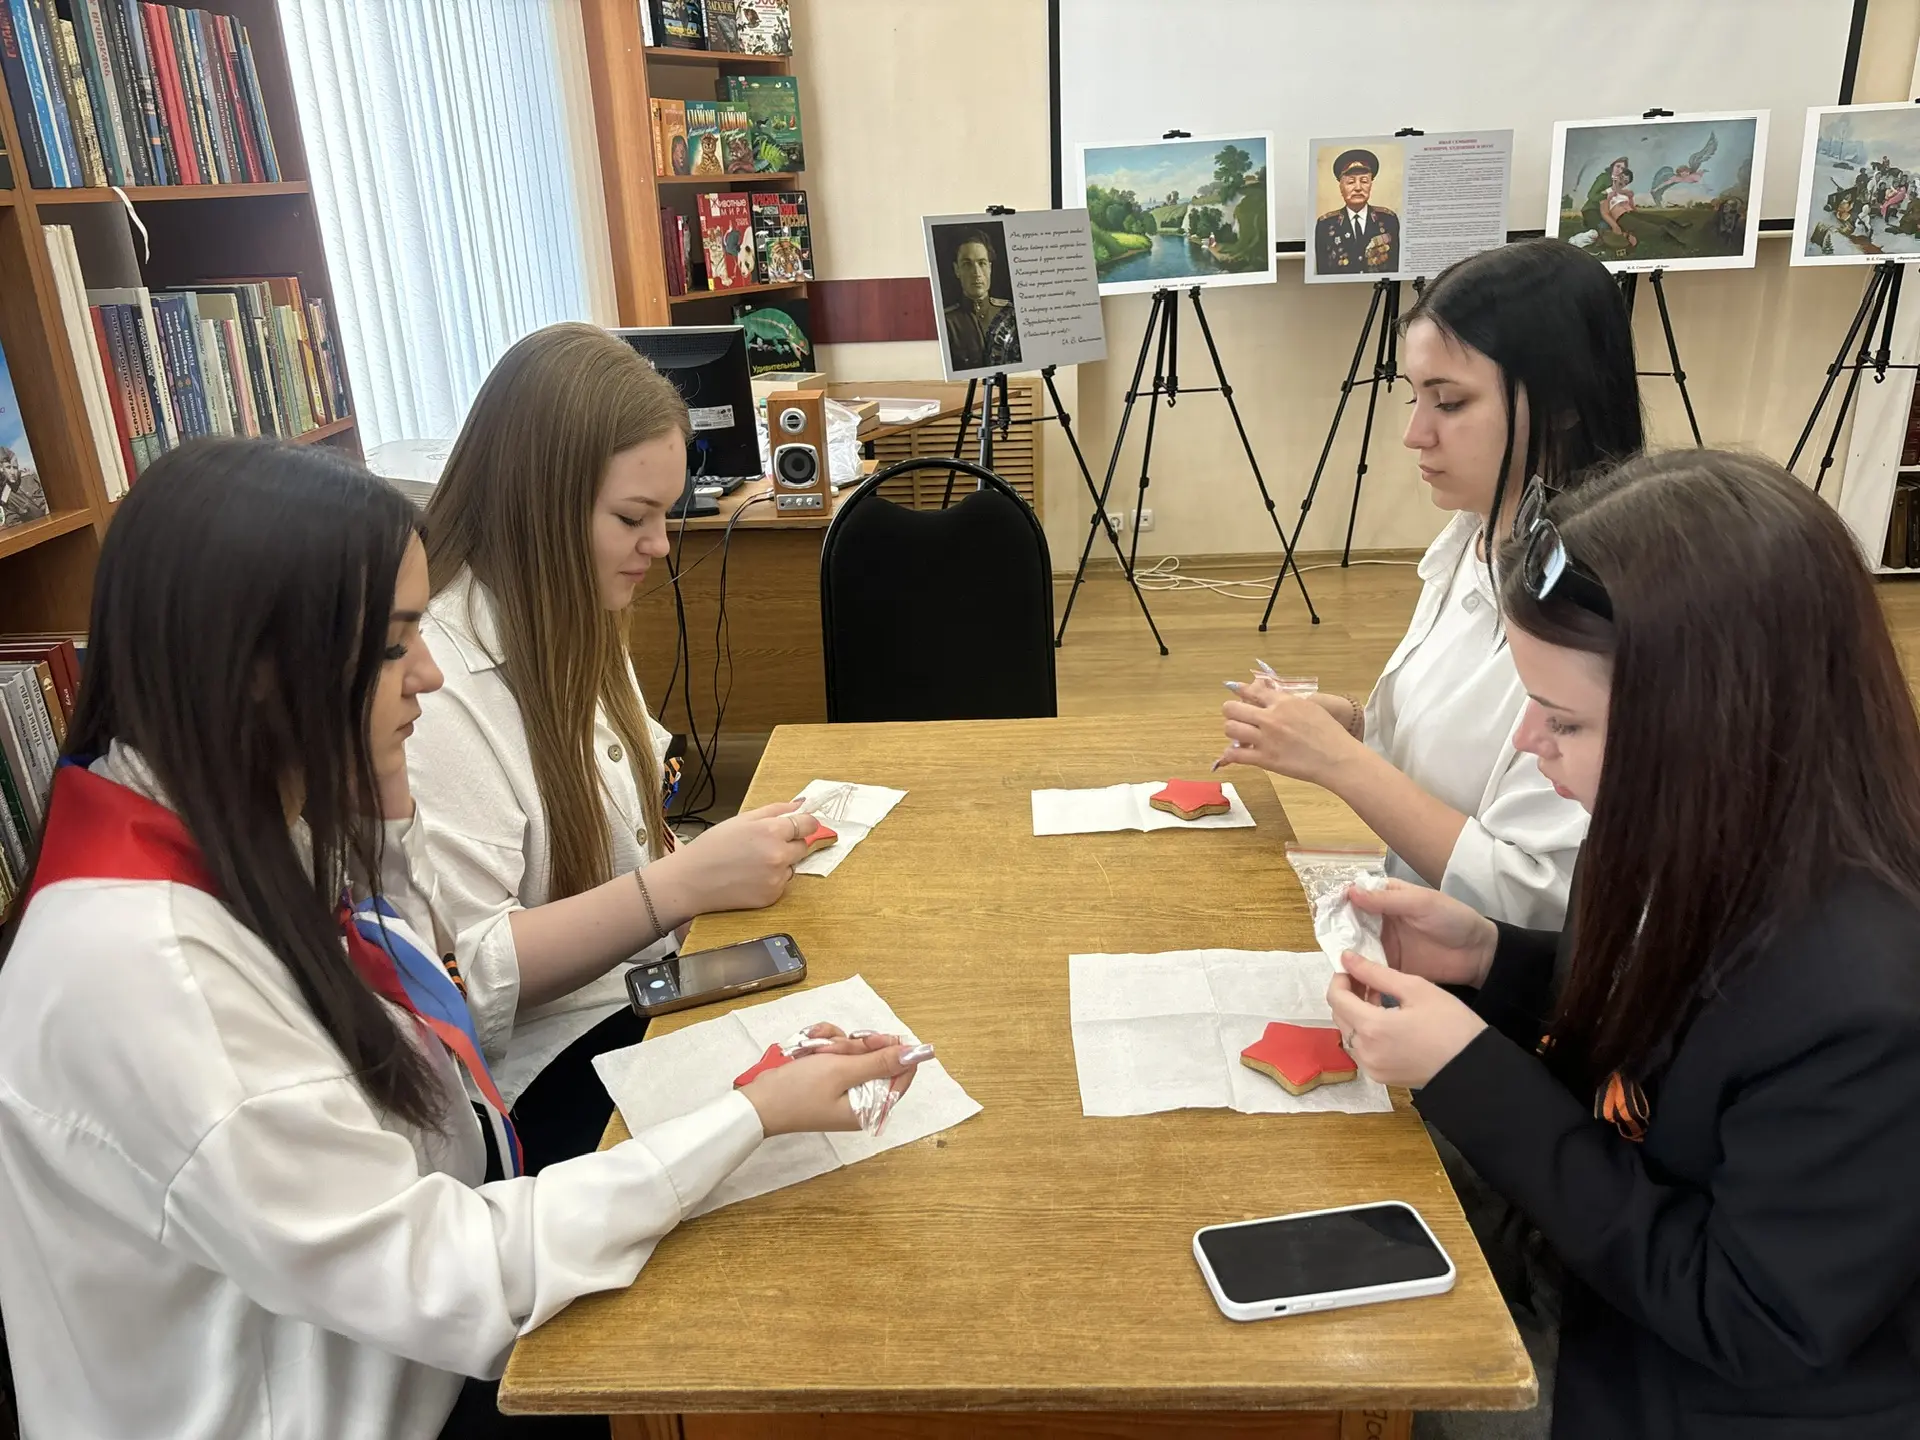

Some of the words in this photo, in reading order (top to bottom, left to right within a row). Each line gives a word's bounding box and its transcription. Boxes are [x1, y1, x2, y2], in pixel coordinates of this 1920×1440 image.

[711, 197, 747, 208] Животные
[721, 208, 748, 216] МИРА
[752, 193, 779, 206] КРАСНАЯ
[781, 214, 808, 227] РОССИИ
[119, 351, 130, 387] СЛЕПОЙ
[132, 348, 143, 384] СЛЕПОЙ
[752, 360, 800, 374] Удивительная
[140, 387, 152, 431] ИСПОВЕДЬ
[159, 372, 172, 423] Литературные
[127, 389, 140, 435] ИСПОВЕДЬ
[19, 685, 31, 710] ВОДЫ
[31, 679, 42, 704] ВОДЫ
